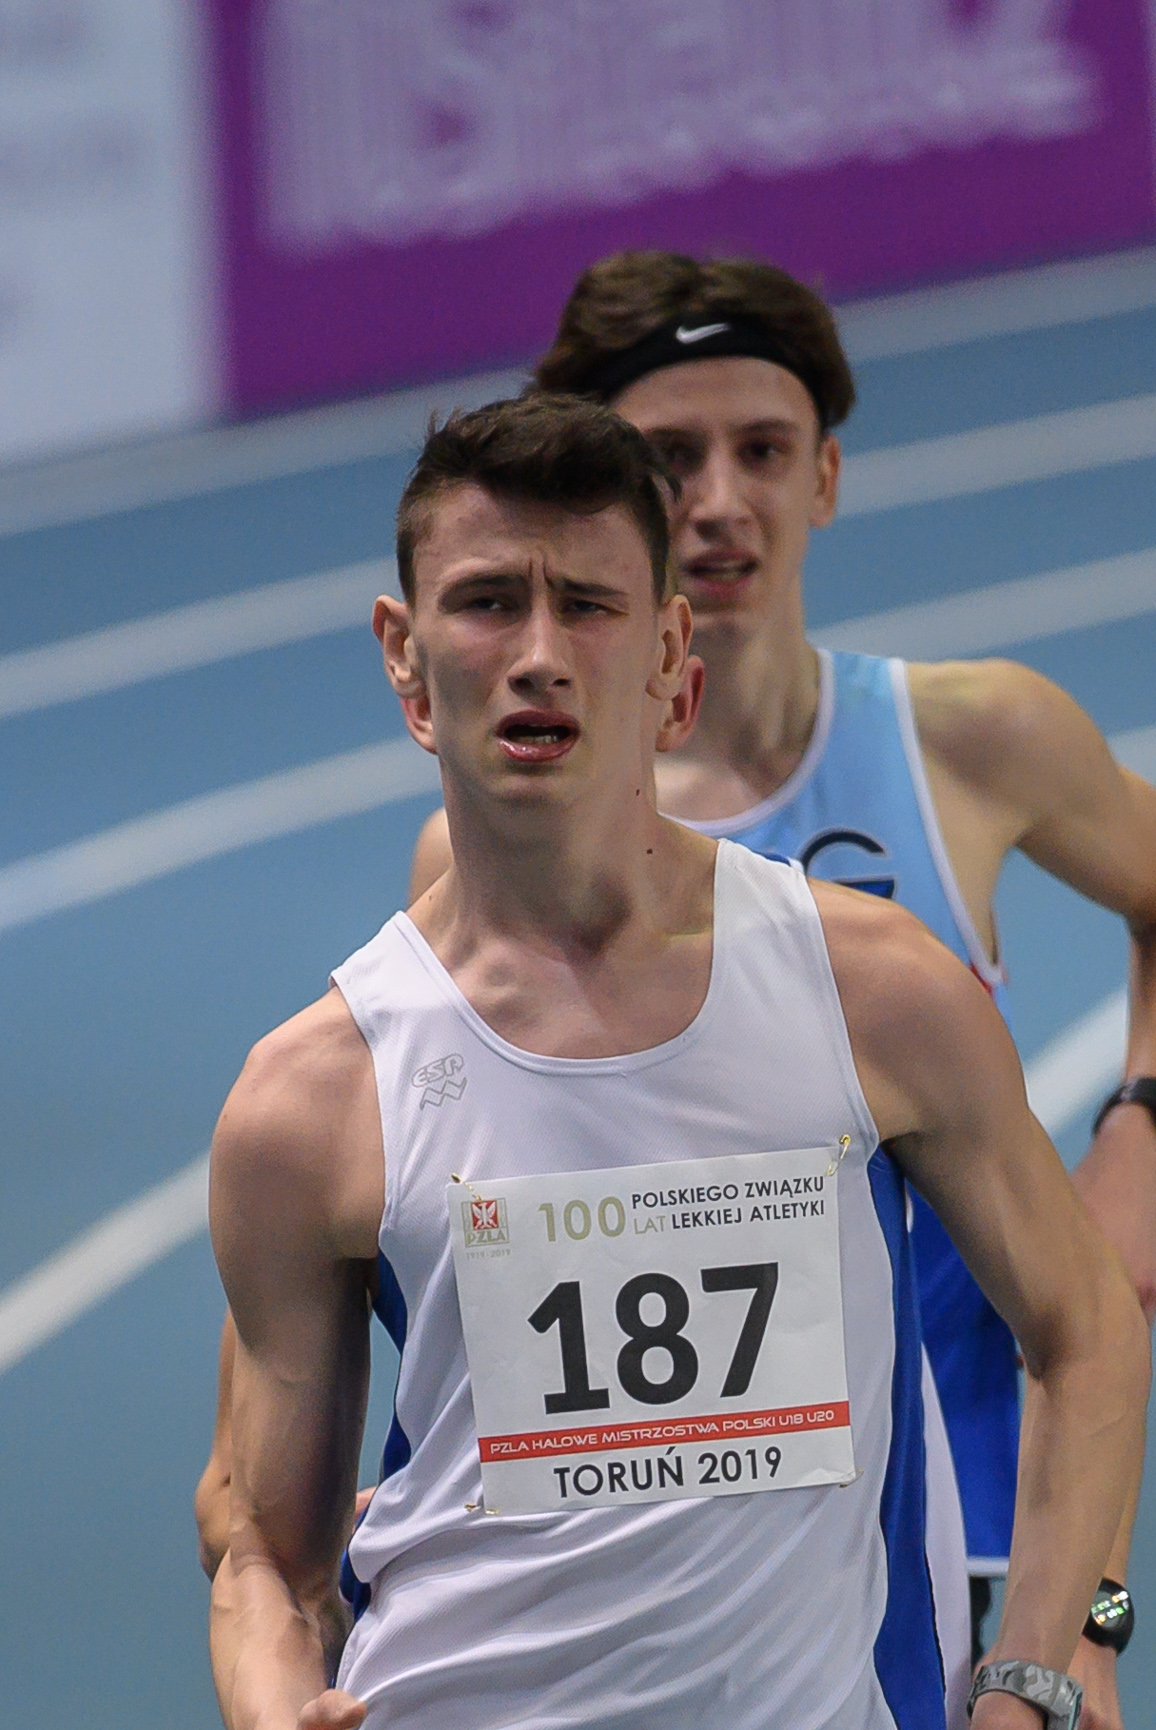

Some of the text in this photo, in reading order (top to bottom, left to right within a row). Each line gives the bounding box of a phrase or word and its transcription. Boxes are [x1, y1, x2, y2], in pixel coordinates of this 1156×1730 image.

[632, 1175, 825, 1209] POLSKIEGO ZWIĄZKU
[538, 1196, 627, 1243] 100
[633, 1199, 825, 1235] LAT LEKKIEJ ATLETYKI
[526, 1261, 780, 1415] 187
[489, 1409, 835, 1455] PZLA HALOWE MISTRZOSTWA POLSKI U18 U20
[552, 1445, 782, 1499] TORUŃ 2019
